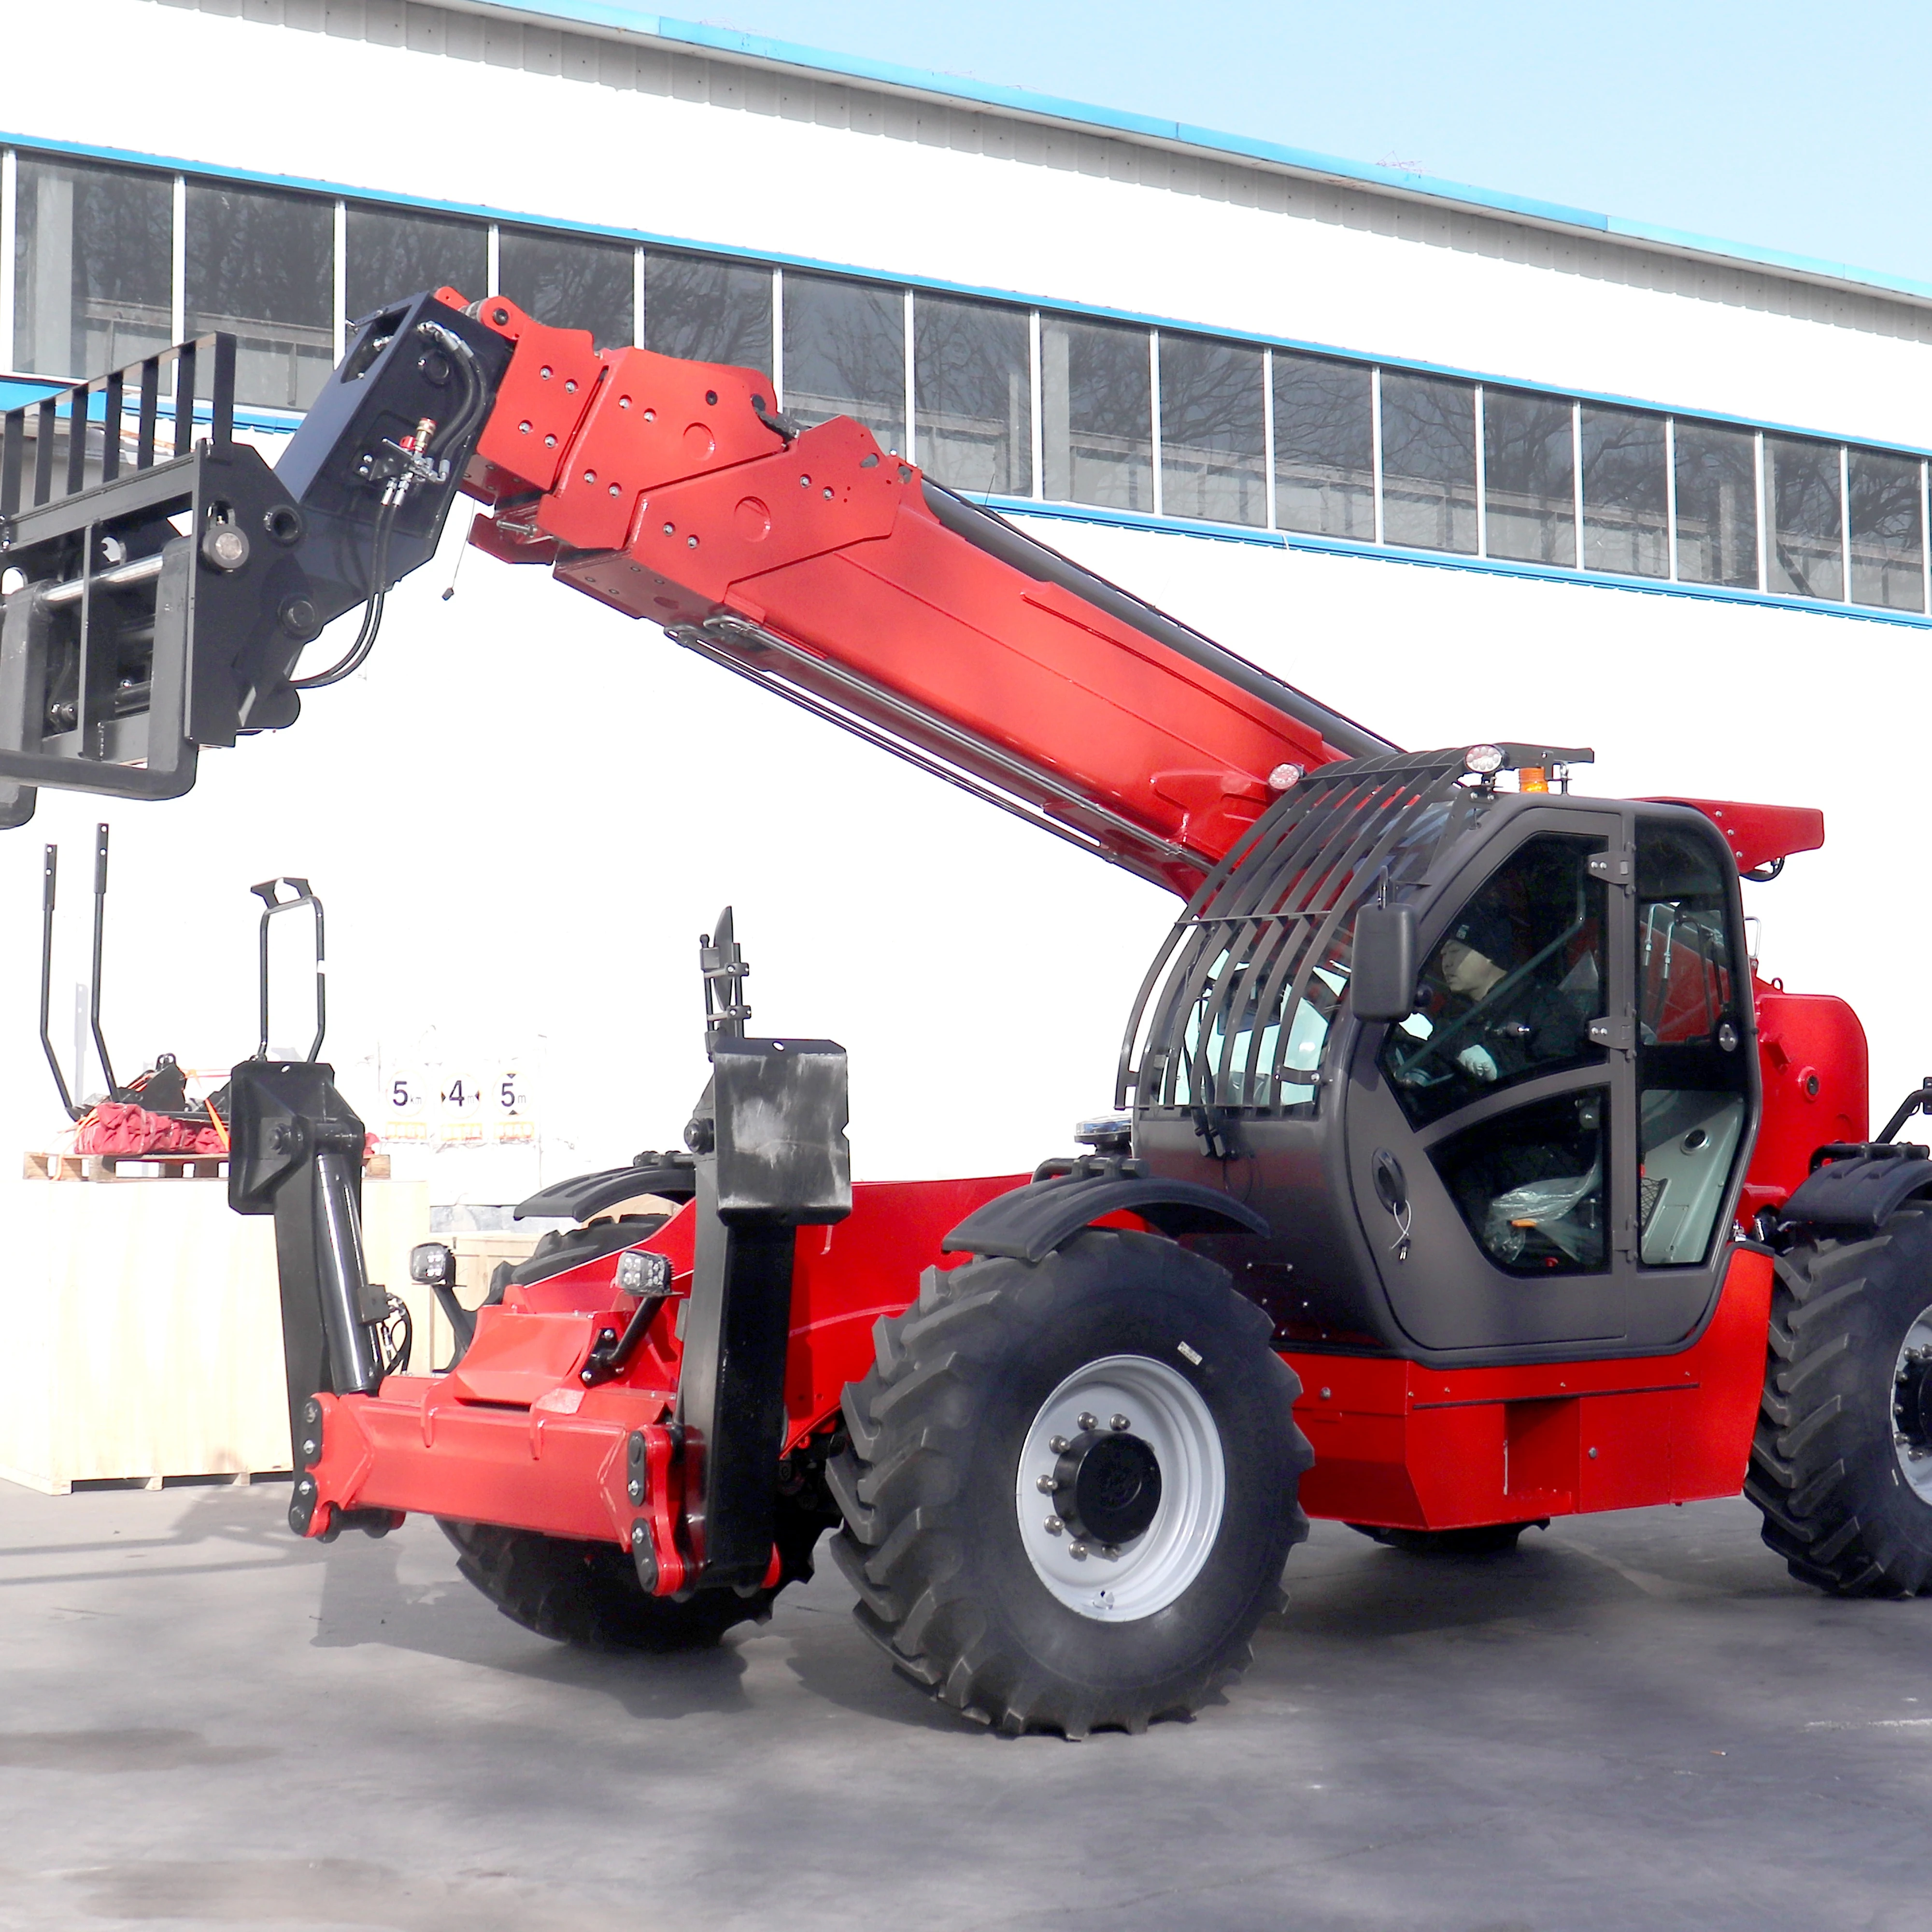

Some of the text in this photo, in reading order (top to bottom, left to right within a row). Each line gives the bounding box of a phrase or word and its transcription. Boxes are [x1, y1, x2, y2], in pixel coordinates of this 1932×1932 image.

[393, 1080, 408, 1106] 5
[449, 1080, 474, 1107] 4 m
[501, 1083, 526, 1107] 5 m
